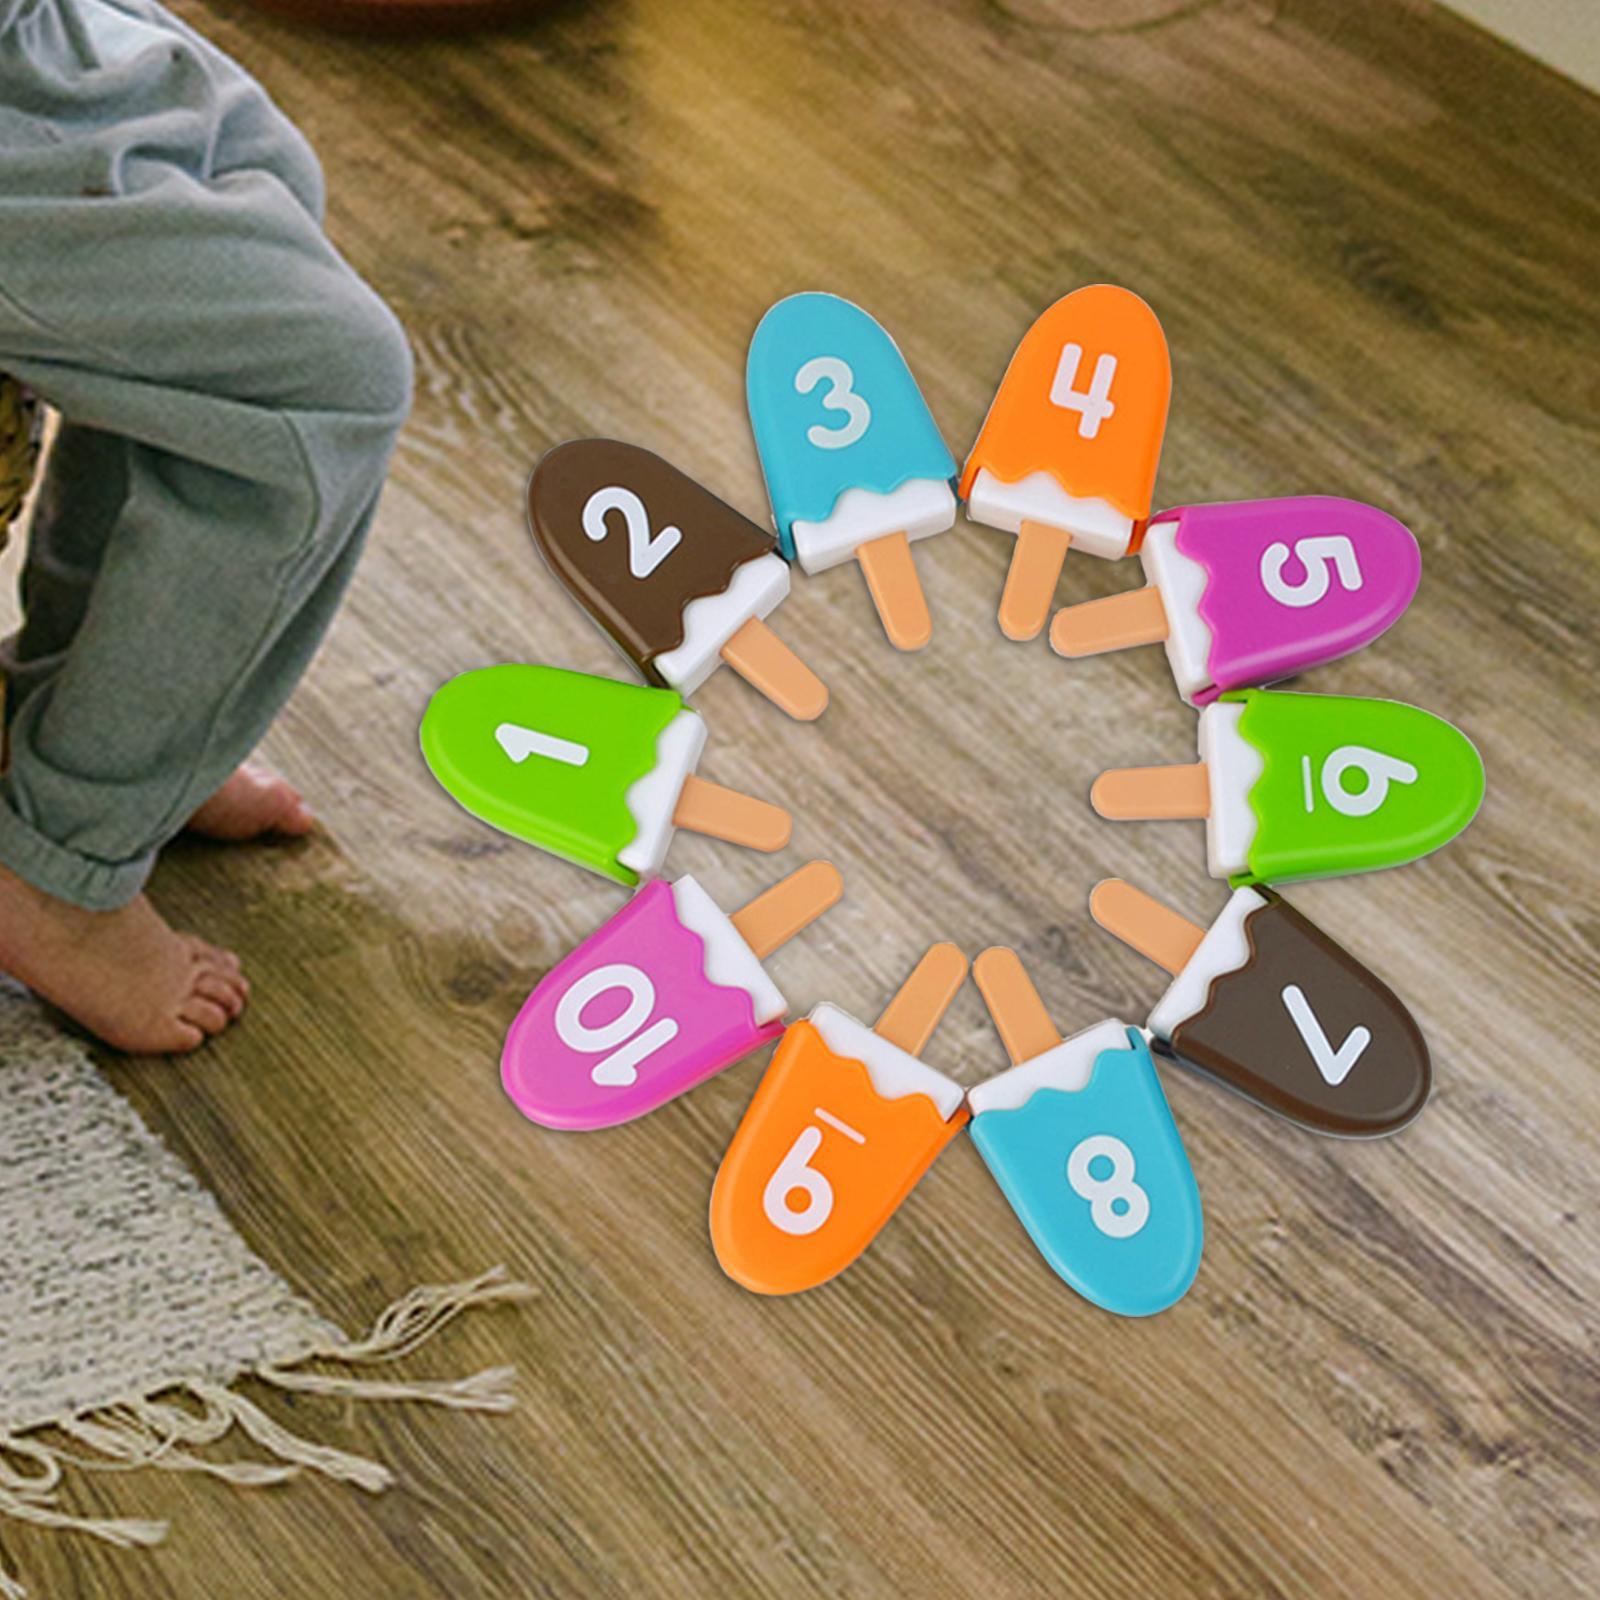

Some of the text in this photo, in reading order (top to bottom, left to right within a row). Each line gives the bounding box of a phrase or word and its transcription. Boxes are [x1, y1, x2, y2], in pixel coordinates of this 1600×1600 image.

[794, 356, 872, 449] 3
[1049, 343, 1117, 439] 4
[582, 486, 682, 579] 2
[1260, 535, 1363, 608] 5
[495, 722, 589, 766] 1
[1321, 745, 1418, 817] 6
[554, 963, 679, 1087] 10
[1281, 984, 1371, 1086] 7
[763, 1126, 835, 1235] 9
[1066, 1134, 1151, 1239] 8
